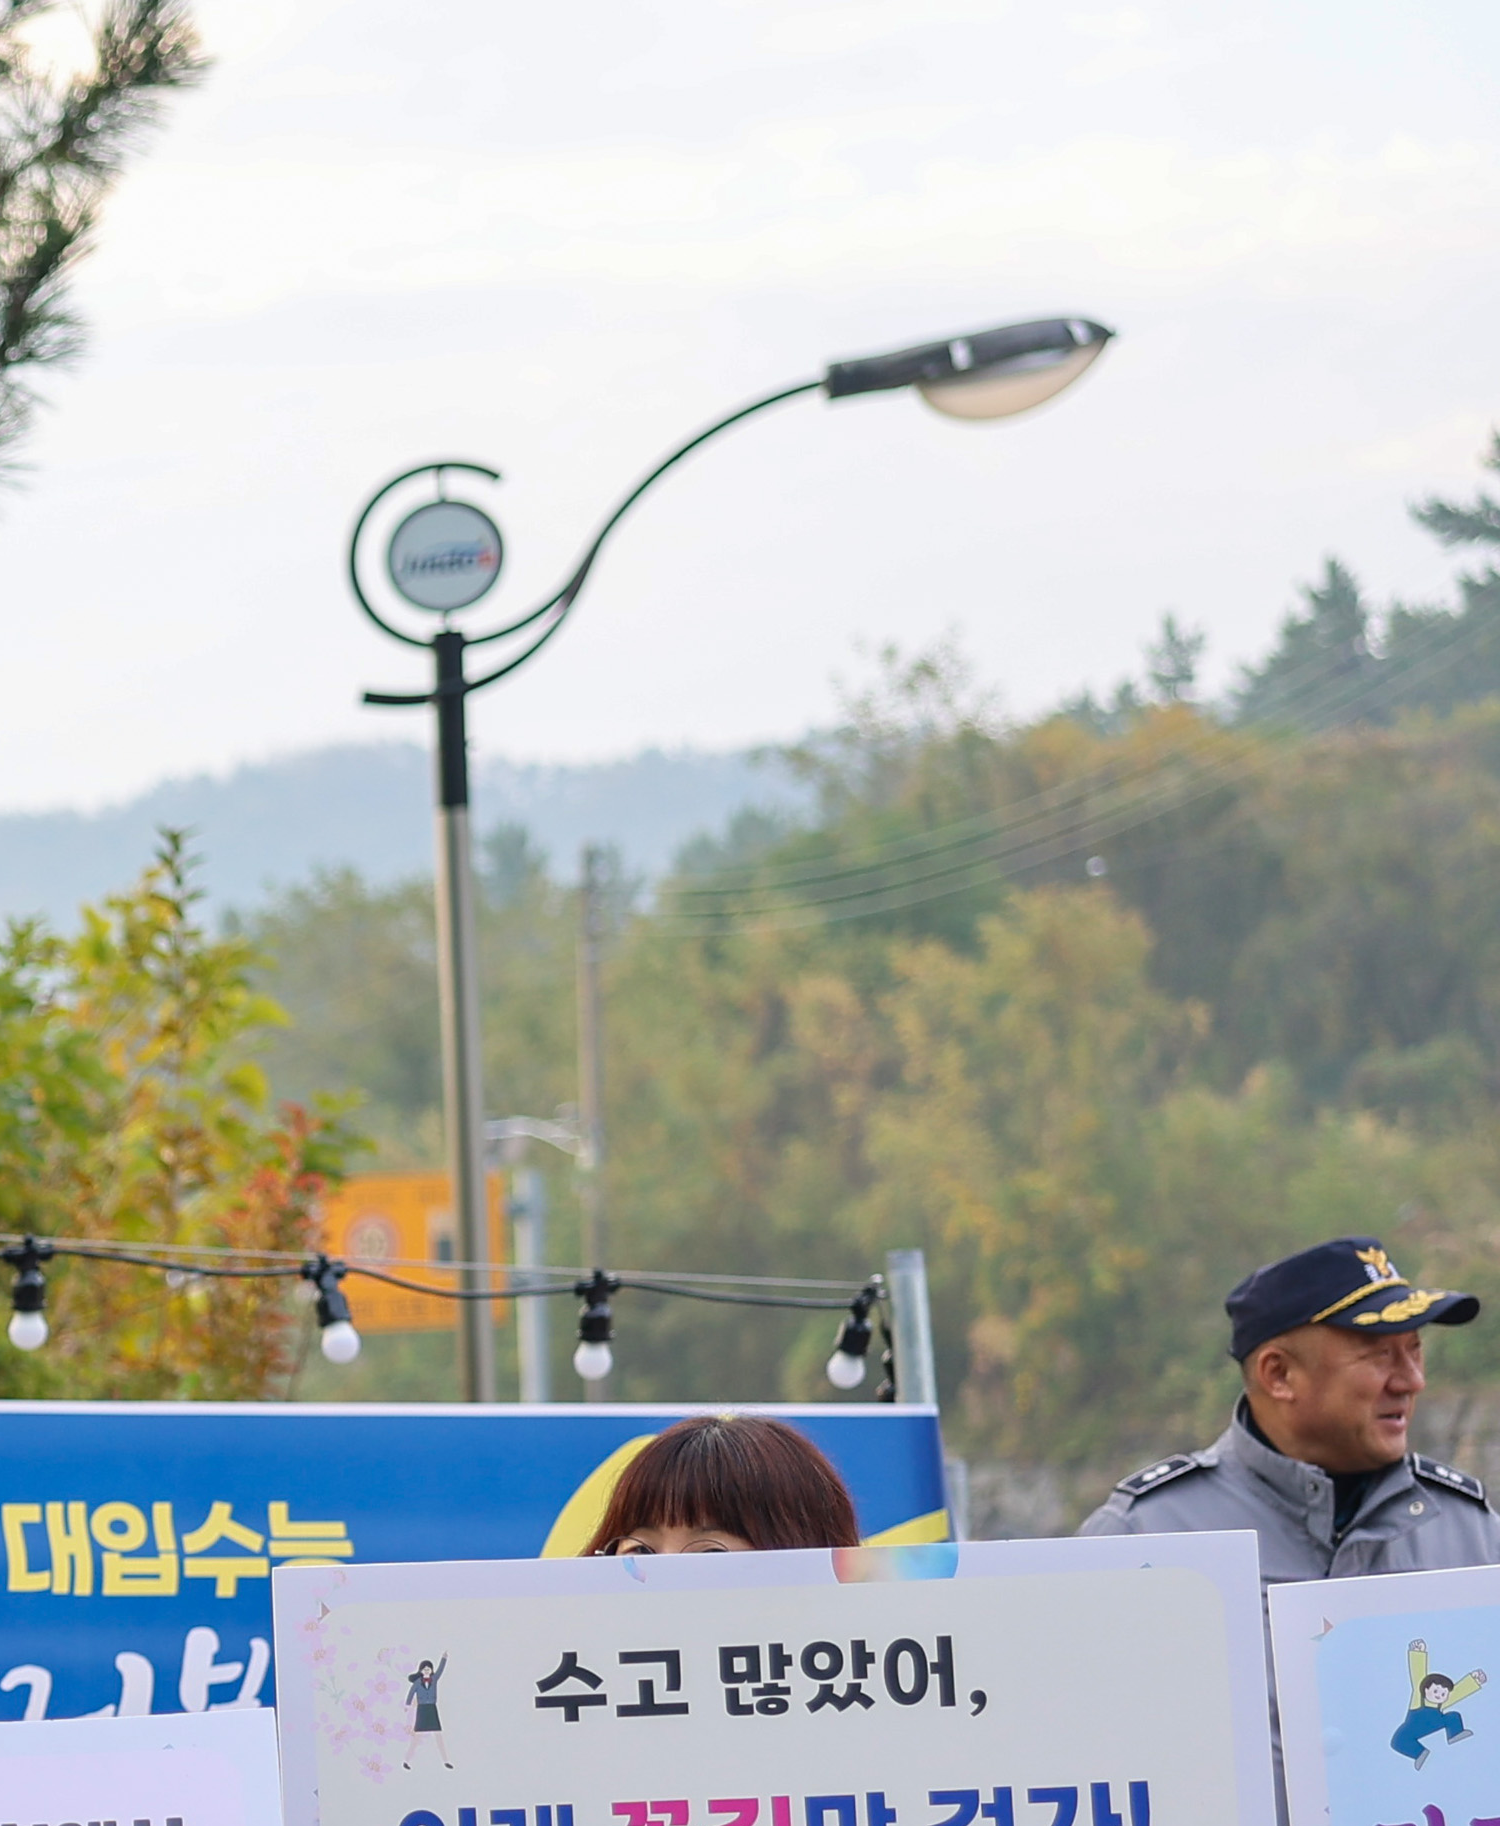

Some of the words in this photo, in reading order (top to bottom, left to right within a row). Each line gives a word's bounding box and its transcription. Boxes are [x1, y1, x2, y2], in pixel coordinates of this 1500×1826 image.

[1, 1501, 354, 1598] 대입수능
[533, 1649, 690, 1723] 수고
[717, 1634, 990, 1718] 많았어,
